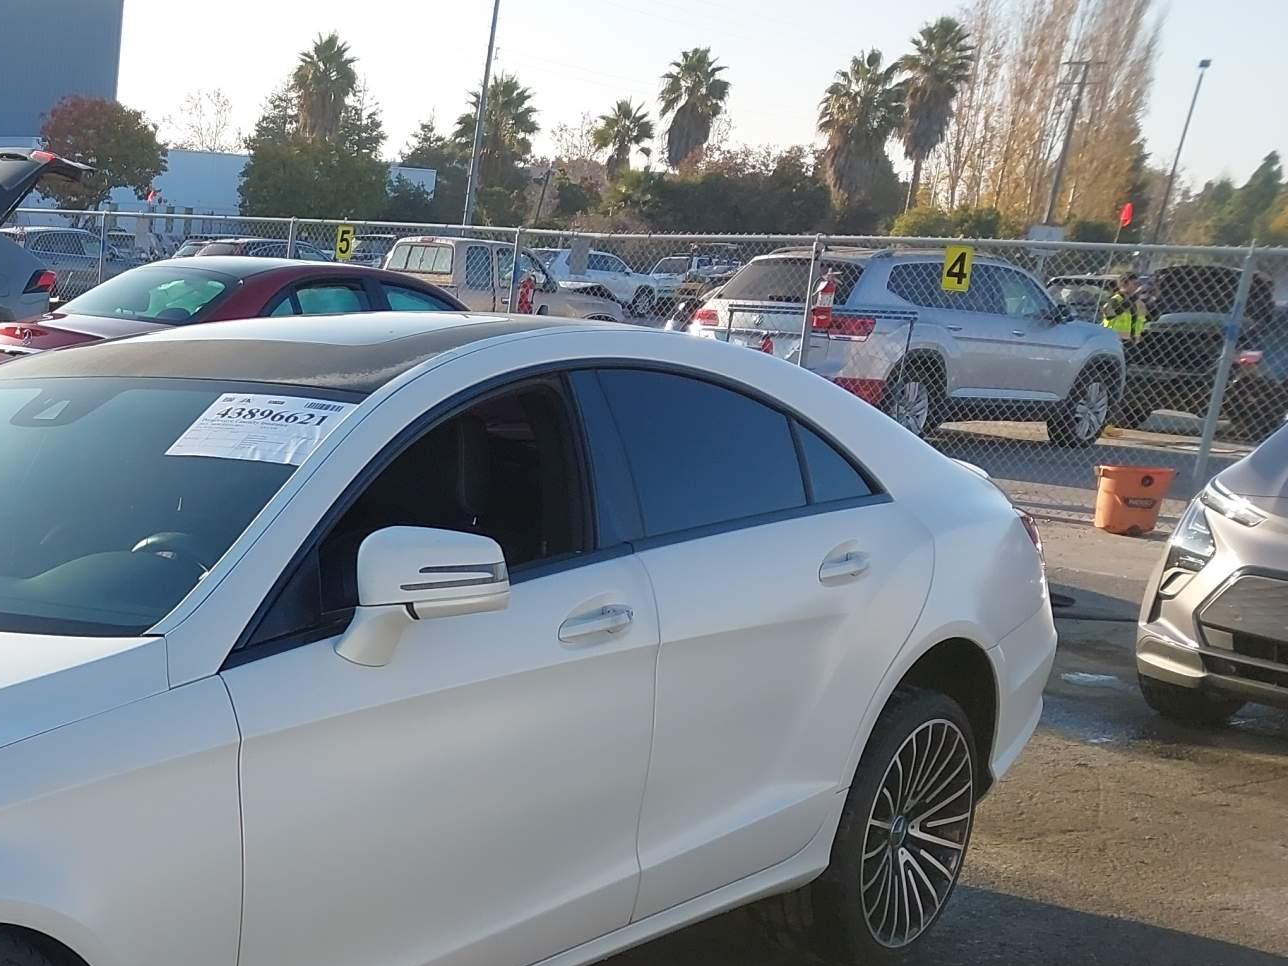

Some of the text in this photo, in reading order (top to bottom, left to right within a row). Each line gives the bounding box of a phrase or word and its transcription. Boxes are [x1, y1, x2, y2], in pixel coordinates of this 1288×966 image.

[338, 229, 351, 254] 5
[945, 251, 968, 285] 4
[215, 405, 330, 427] 43896621
